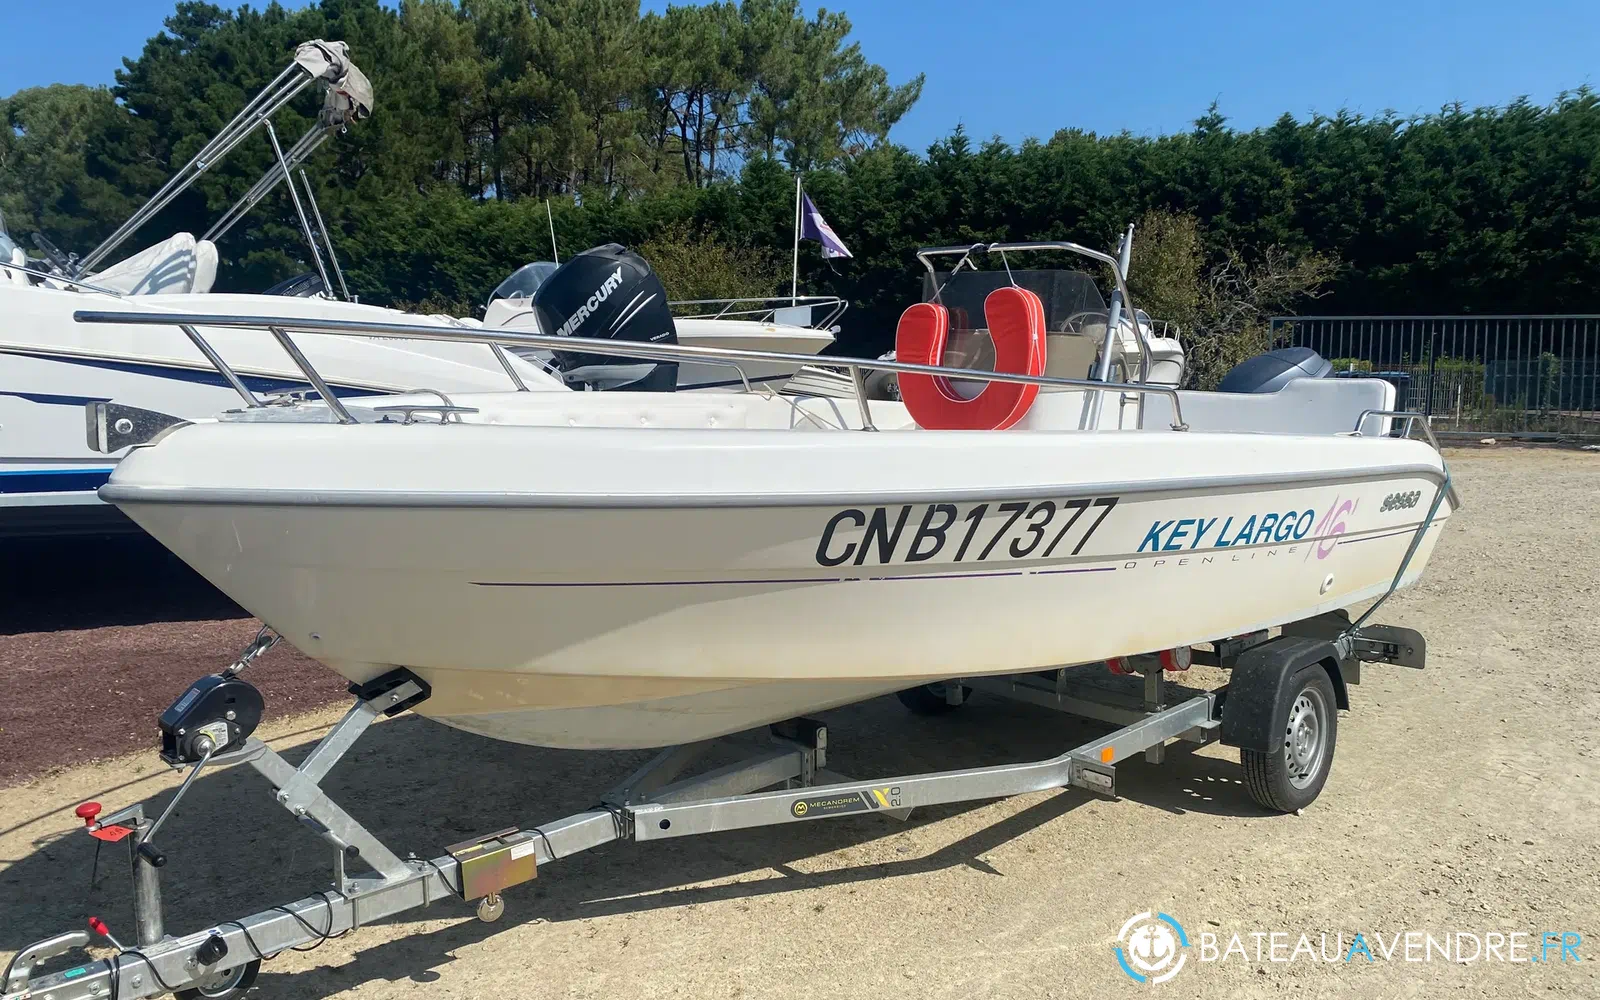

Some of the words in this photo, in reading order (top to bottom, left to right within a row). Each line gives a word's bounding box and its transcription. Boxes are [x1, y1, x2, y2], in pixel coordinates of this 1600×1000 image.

[556, 266, 623, 337] MERCURY
[1136, 517, 1218, 552] KEY
[1214, 509, 1315, 547] LARGO
[1124, 557, 1214, 570] OPEN
[1231, 546, 1298, 562] LINE
[809, 797, 860, 808] MECANOREM
